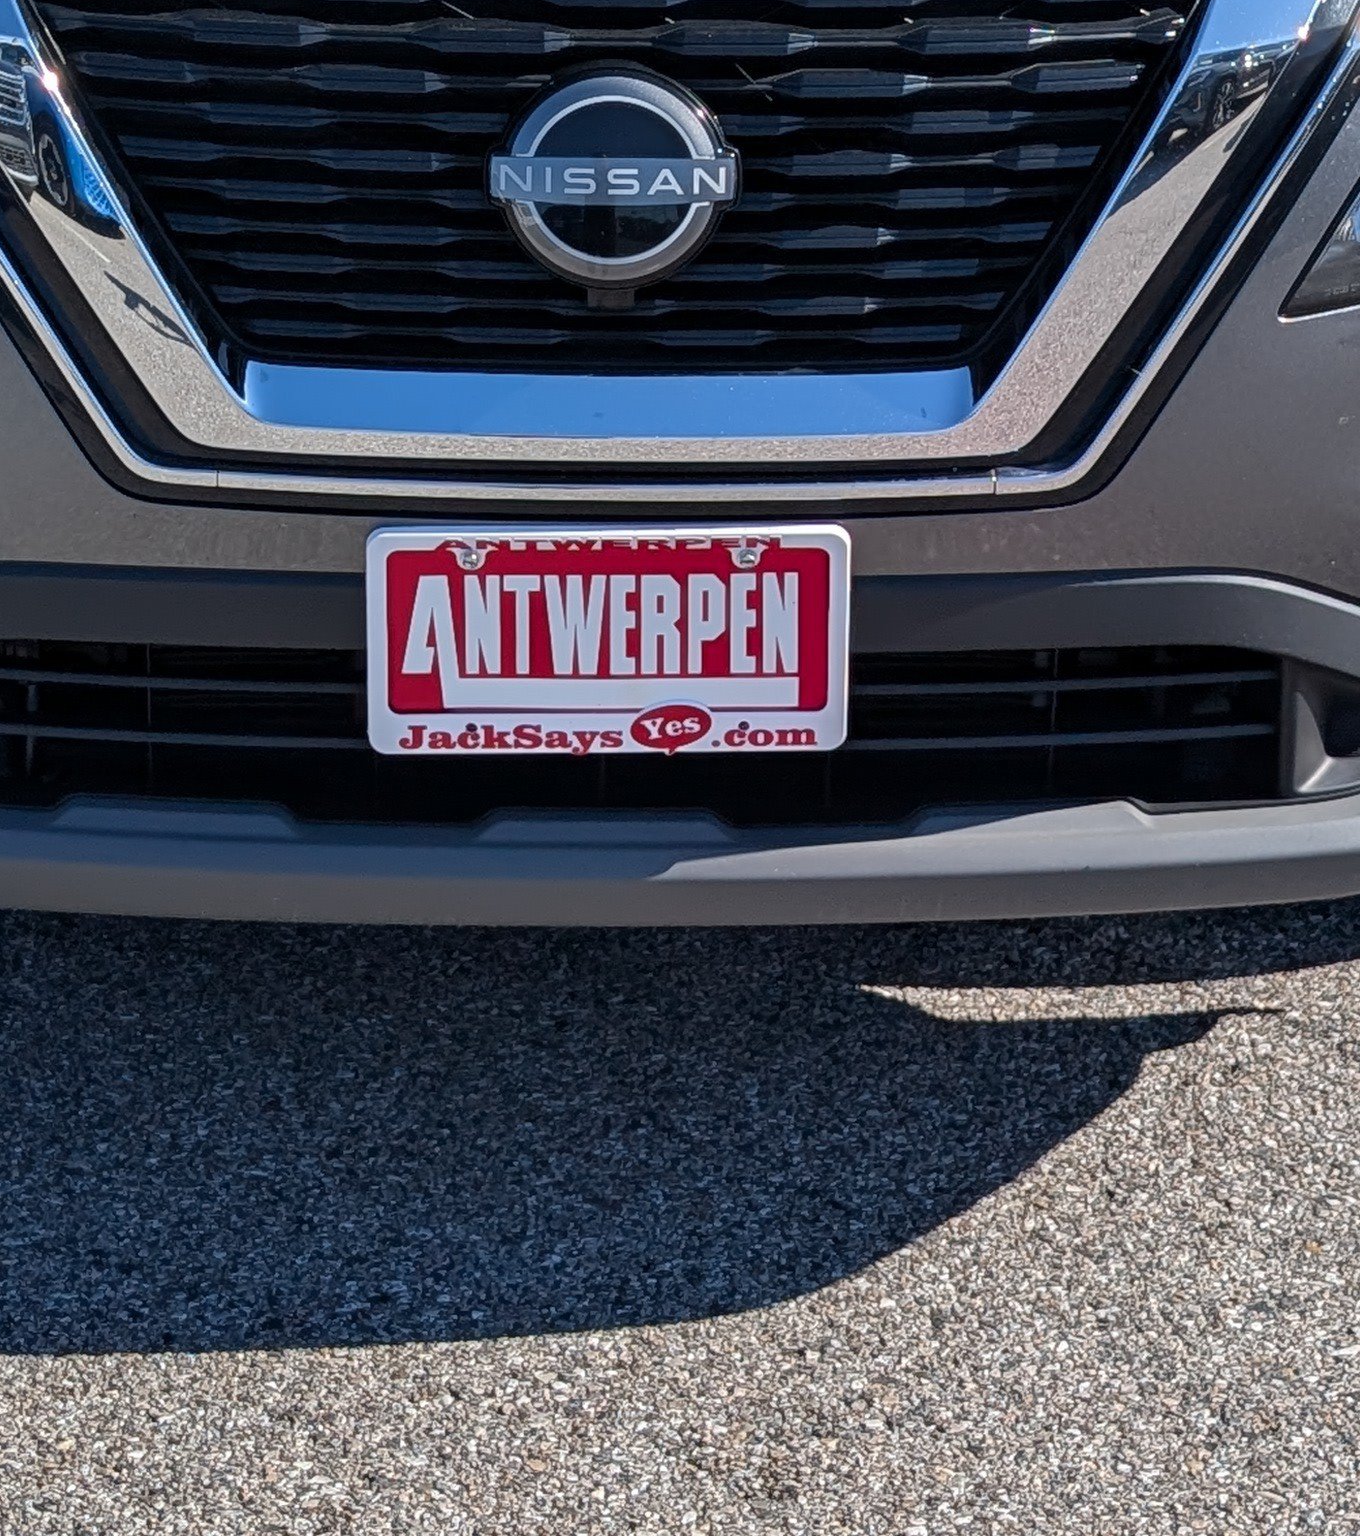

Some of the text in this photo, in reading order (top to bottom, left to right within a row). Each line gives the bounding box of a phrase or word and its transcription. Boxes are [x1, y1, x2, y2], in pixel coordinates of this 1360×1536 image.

[499, 165, 727, 196] NISSAN
[401, 572, 799, 676] ANTWERPEN
[399, 716, 818, 755] JackSays Yes .com
